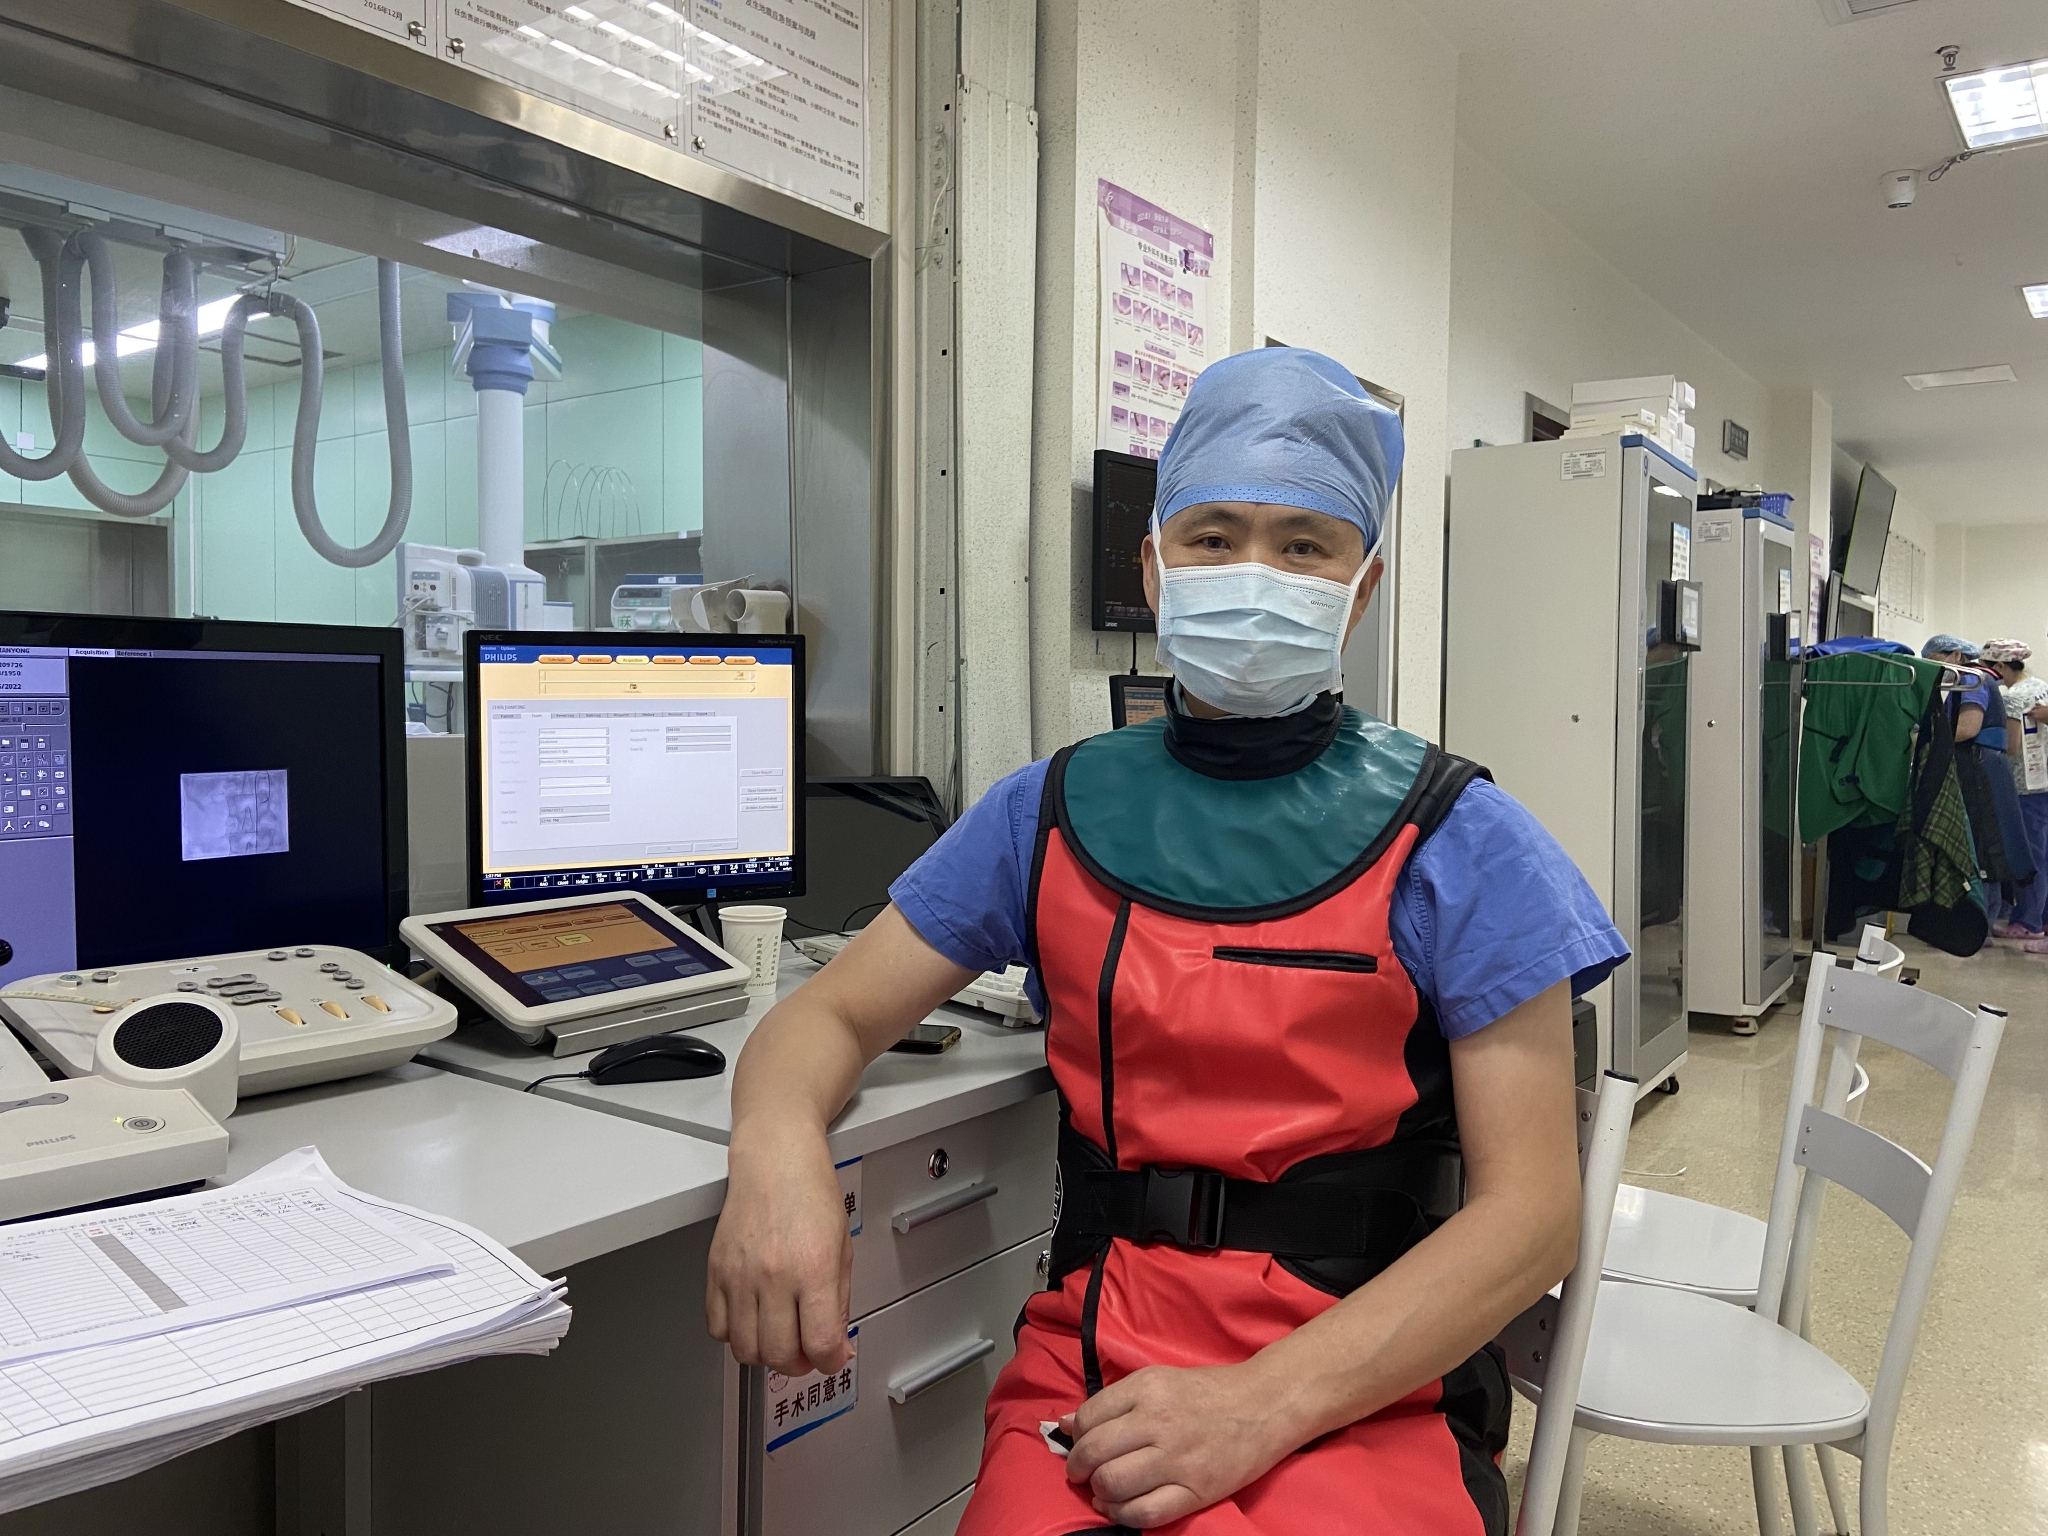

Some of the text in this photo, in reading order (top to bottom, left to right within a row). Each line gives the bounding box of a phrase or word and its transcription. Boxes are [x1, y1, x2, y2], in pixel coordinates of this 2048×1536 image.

[364, 0, 402, 20] 2016年12月
[1644, 455, 1648, 477] 9
[1310, 600, 1336, 610] winner
[485, 653, 517, 662] PHILIPS
[643, 1005, 668, 1014] PHILIPS
[26, 1134, 76, 1147] PHILIPS
[774, 1368, 852, 1427] 手术同意书
